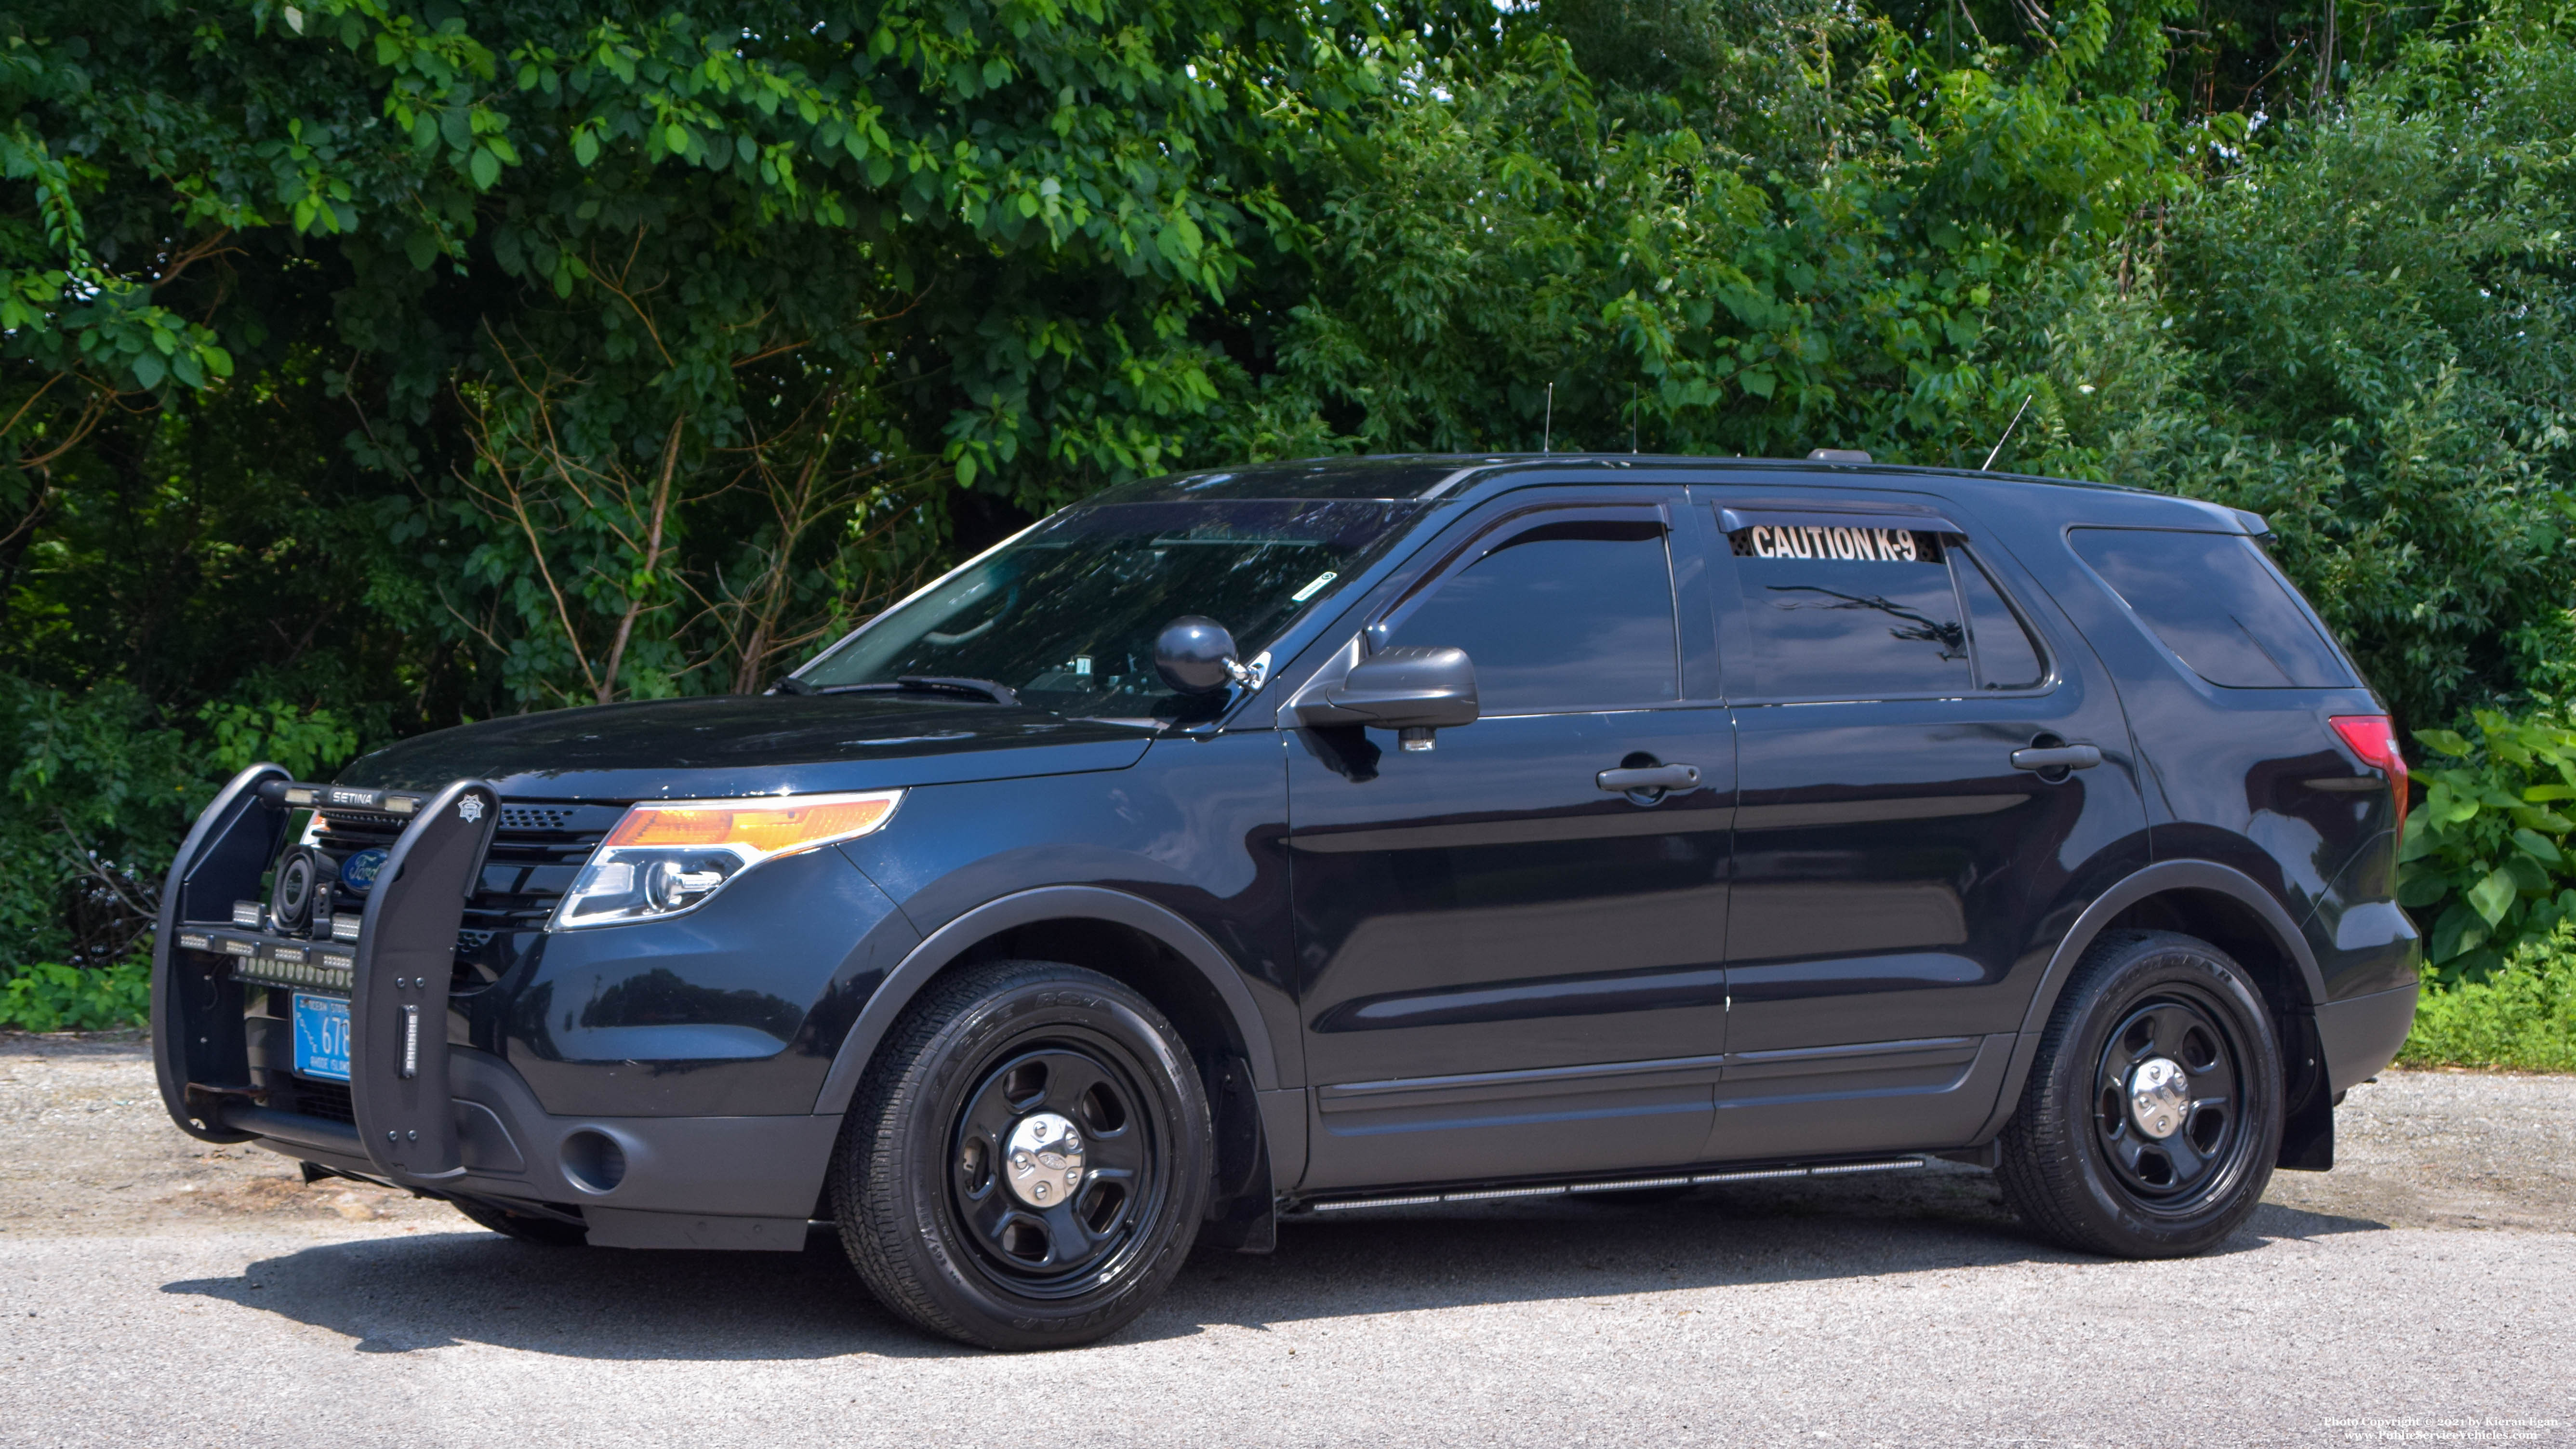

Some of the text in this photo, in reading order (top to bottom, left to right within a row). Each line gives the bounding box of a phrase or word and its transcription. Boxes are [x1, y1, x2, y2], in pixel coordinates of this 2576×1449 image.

[1753, 525, 1916, 561] CAUTION K-9
[333, 792, 372, 805] SETINA
[349, 854, 388, 881] Ford
[322, 1017, 350, 1057] 678
[310, 1056, 329, 1069] RHODE
